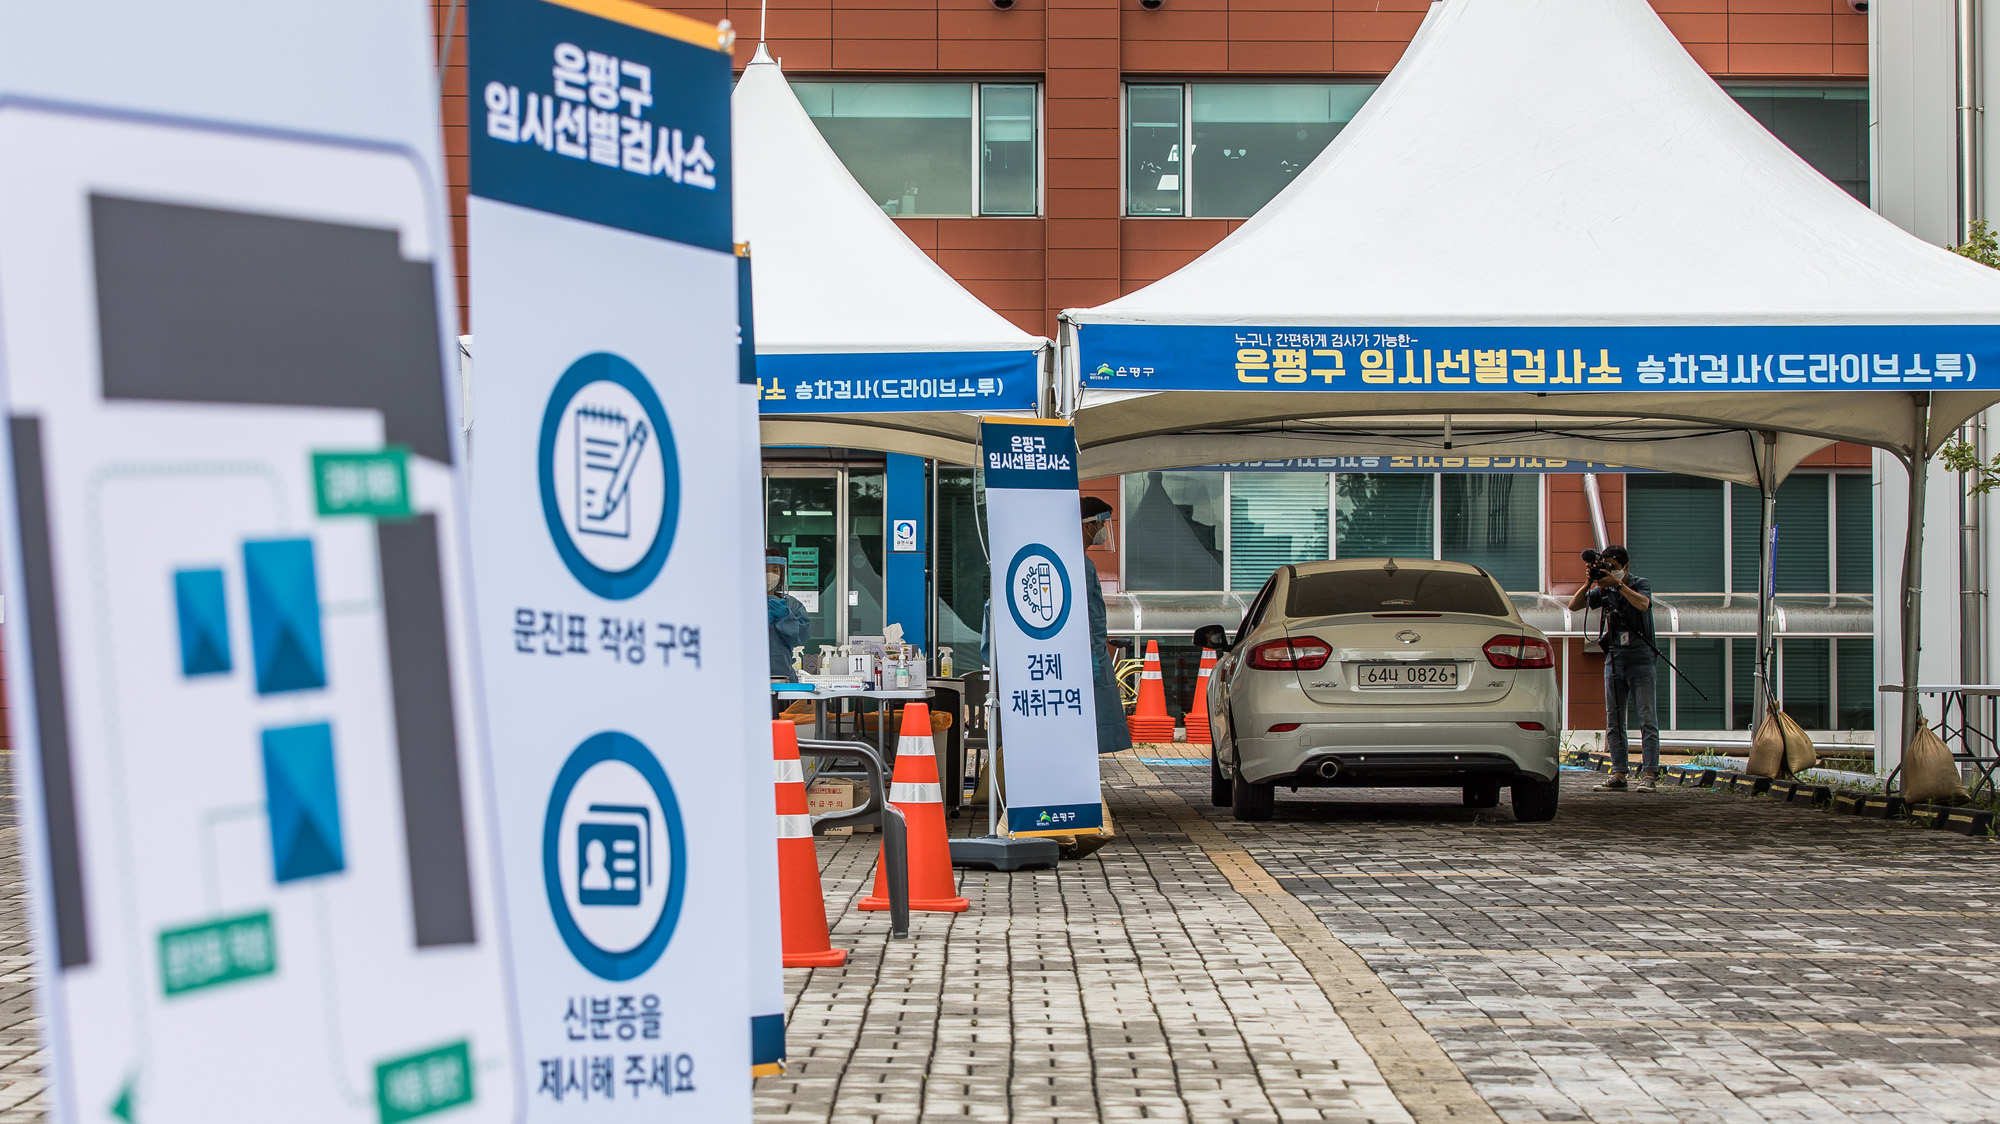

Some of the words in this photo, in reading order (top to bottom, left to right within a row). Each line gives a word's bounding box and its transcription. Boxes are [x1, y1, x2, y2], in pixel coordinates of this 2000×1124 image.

[552, 42, 653, 118] 은평구
[484, 81, 716, 190] 임시선별검사소
[1235, 333, 1272, 347] 누구나
[1275, 333, 1327, 347] 간편하게
[1331, 333, 1369, 347] 검사가
[1116, 366, 1155, 378] 은평구
[1235, 348, 1346, 384] 은평구
[1359, 348, 1623, 384] 임시선별검사소
[1636, 353, 1977, 384] 승차검사(드라이브스루)
[795, 377, 1004, 400] 승차검사(드라이브스루)
[1011, 435, 1046, 453] 은평구
[989, 452, 1071, 470] 임시선별검사소
[514, 607, 589, 656] 문진표
[600, 616, 646, 665] 작성
[655, 622, 702, 671] 구역
[1027, 653, 1063, 681] 검체
[1368, 667, 1399, 683] 64나
[1407, 667, 1448, 683] 0826
[1012, 688, 1082, 717] 채취구역
[1051, 812, 1076, 822] 은평구
[563, 993, 662, 1041] 신분증을
[537, 1055, 615, 1102] 제시해
[623, 1053, 696, 1099] 주세요
